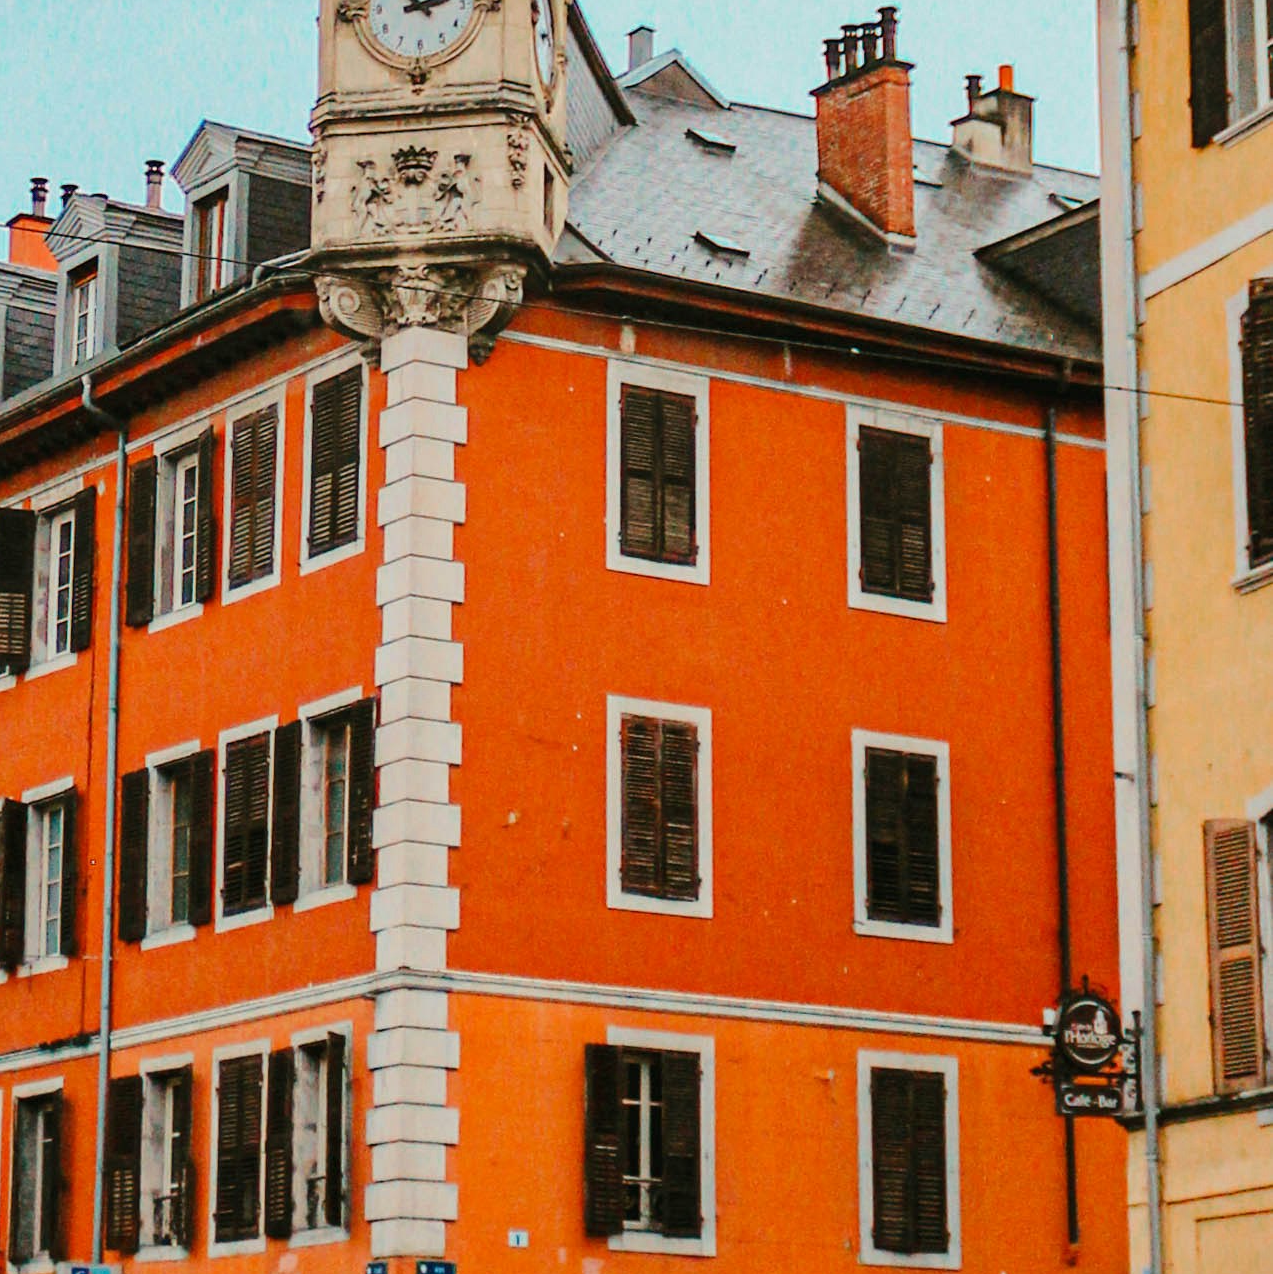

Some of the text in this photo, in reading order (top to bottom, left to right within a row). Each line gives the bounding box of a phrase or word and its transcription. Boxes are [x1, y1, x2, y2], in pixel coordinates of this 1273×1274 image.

[376, 4, 383, 15] 9
[459, 0, 466, 10] 3
[382, 23, 389, 34] 8
[453, 19, 458, 28] 4
[396, 36, 403, 48] 7
[439, 33, 446, 44] 5
[417, 39, 424, 50] 6
[1098, 1094, 1118, 1108] Bar
